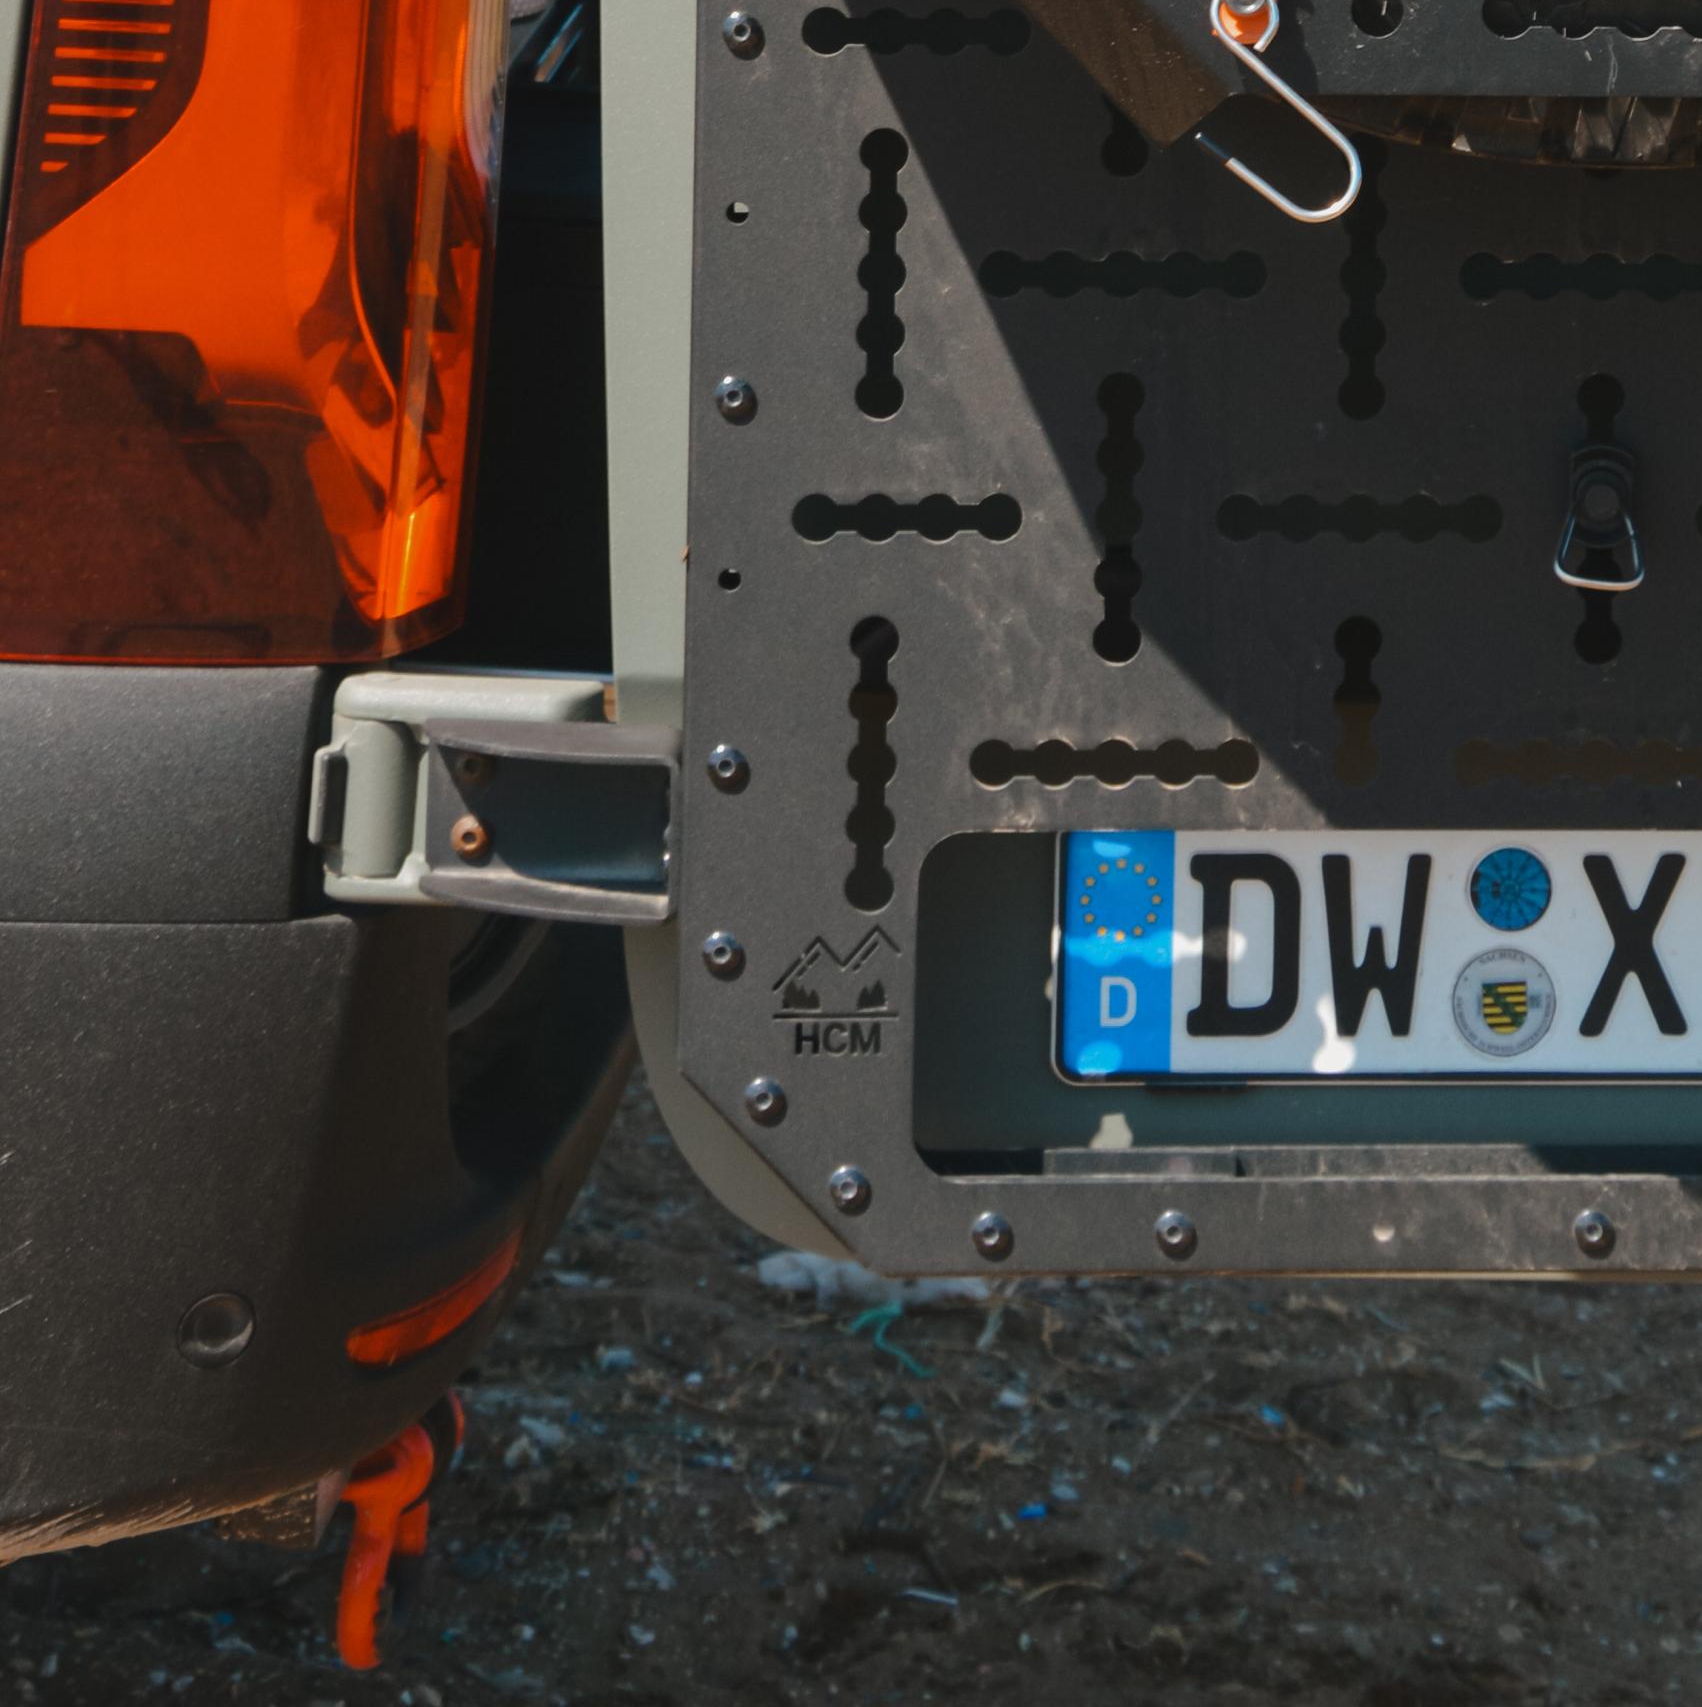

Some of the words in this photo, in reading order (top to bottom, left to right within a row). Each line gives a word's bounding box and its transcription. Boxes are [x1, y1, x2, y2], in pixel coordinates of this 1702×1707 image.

[1186, 853, 1432, 1037] DW
[1101, 976, 1137, 1027] D
[794, 1021, 882, 1056] HCM
